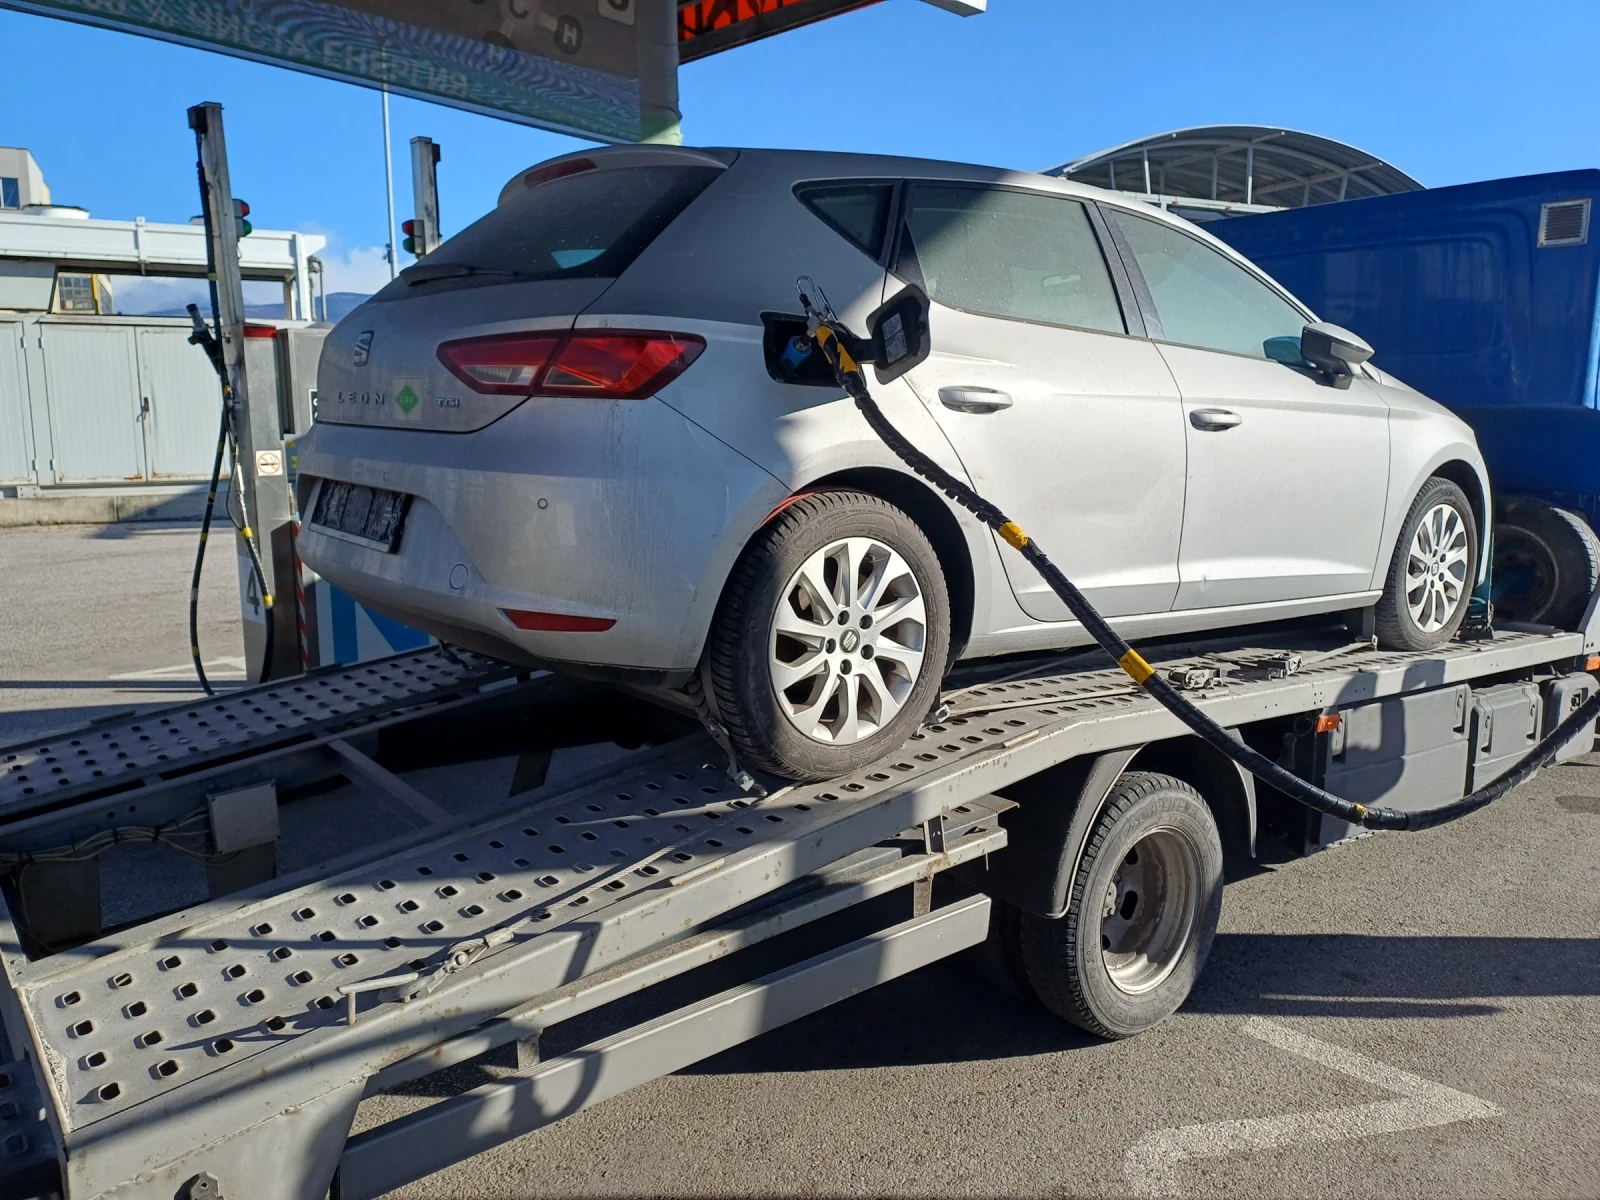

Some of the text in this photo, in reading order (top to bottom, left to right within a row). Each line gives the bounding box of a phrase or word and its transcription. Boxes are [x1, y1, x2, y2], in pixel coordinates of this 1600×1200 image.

[323, 39, 469, 99] ЕНЕРГИЯ
[338, 391, 385, 406] LEON
[436, 396, 460, 409] TGI
[247, 567, 260, 615] 4
